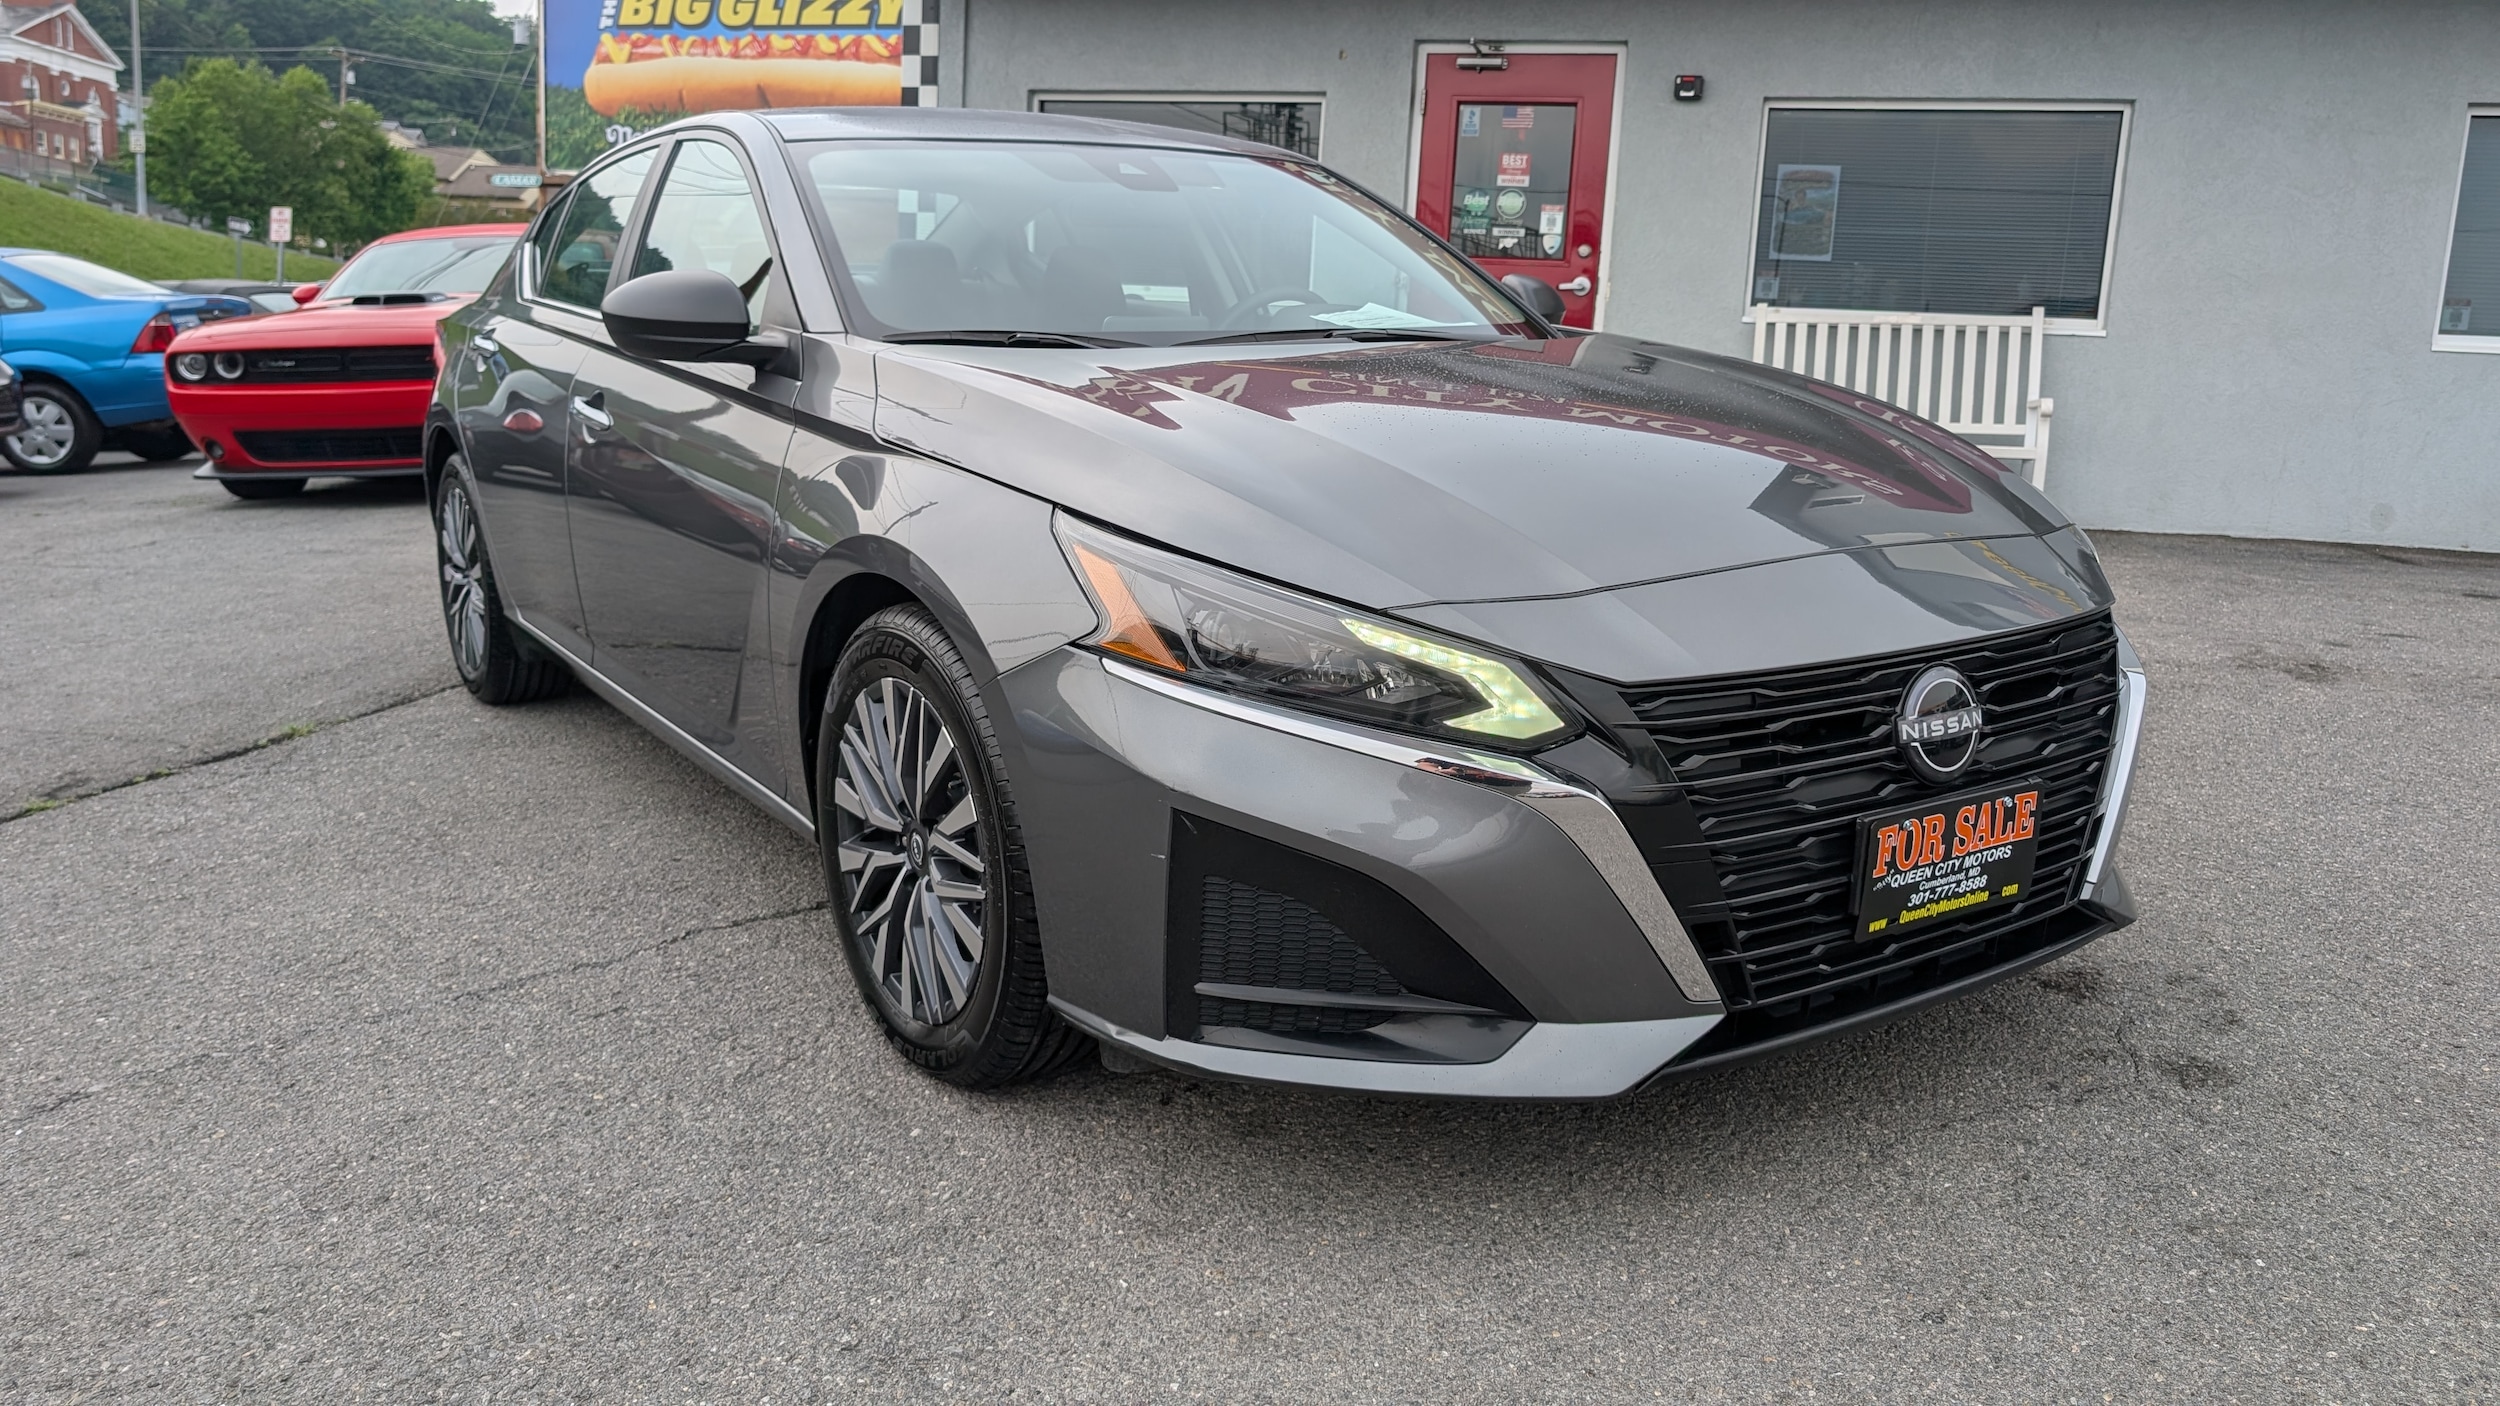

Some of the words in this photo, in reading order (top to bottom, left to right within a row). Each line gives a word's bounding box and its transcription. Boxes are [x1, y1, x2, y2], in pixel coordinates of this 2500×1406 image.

[599, 0, 618, 29] TH
[616, 0, 713, 28] BIG
[717, 0, 904, 28] GLIZZY
[1502, 154, 1528, 166] BEST
[1901, 709, 1982, 740] NISSAN
[1872, 813, 1946, 878] FOR
[1952, 791, 2038, 857] SALE
[1890, 865, 1933, 887] QUEEN
[1935, 858, 1963, 877] CITY
[1963, 845, 2013, 869] MOTORS
[1919, 871, 1967, 890] Cumberland,
[1968, 866, 1981, 878] MD
[1907, 874, 1988, 907] 301-777-8588
[1868, 918, 1888, 933] www
[1899, 890, 1989, 924] QueenCityMotorsOnline
[2001, 883, 2019, 898] com
